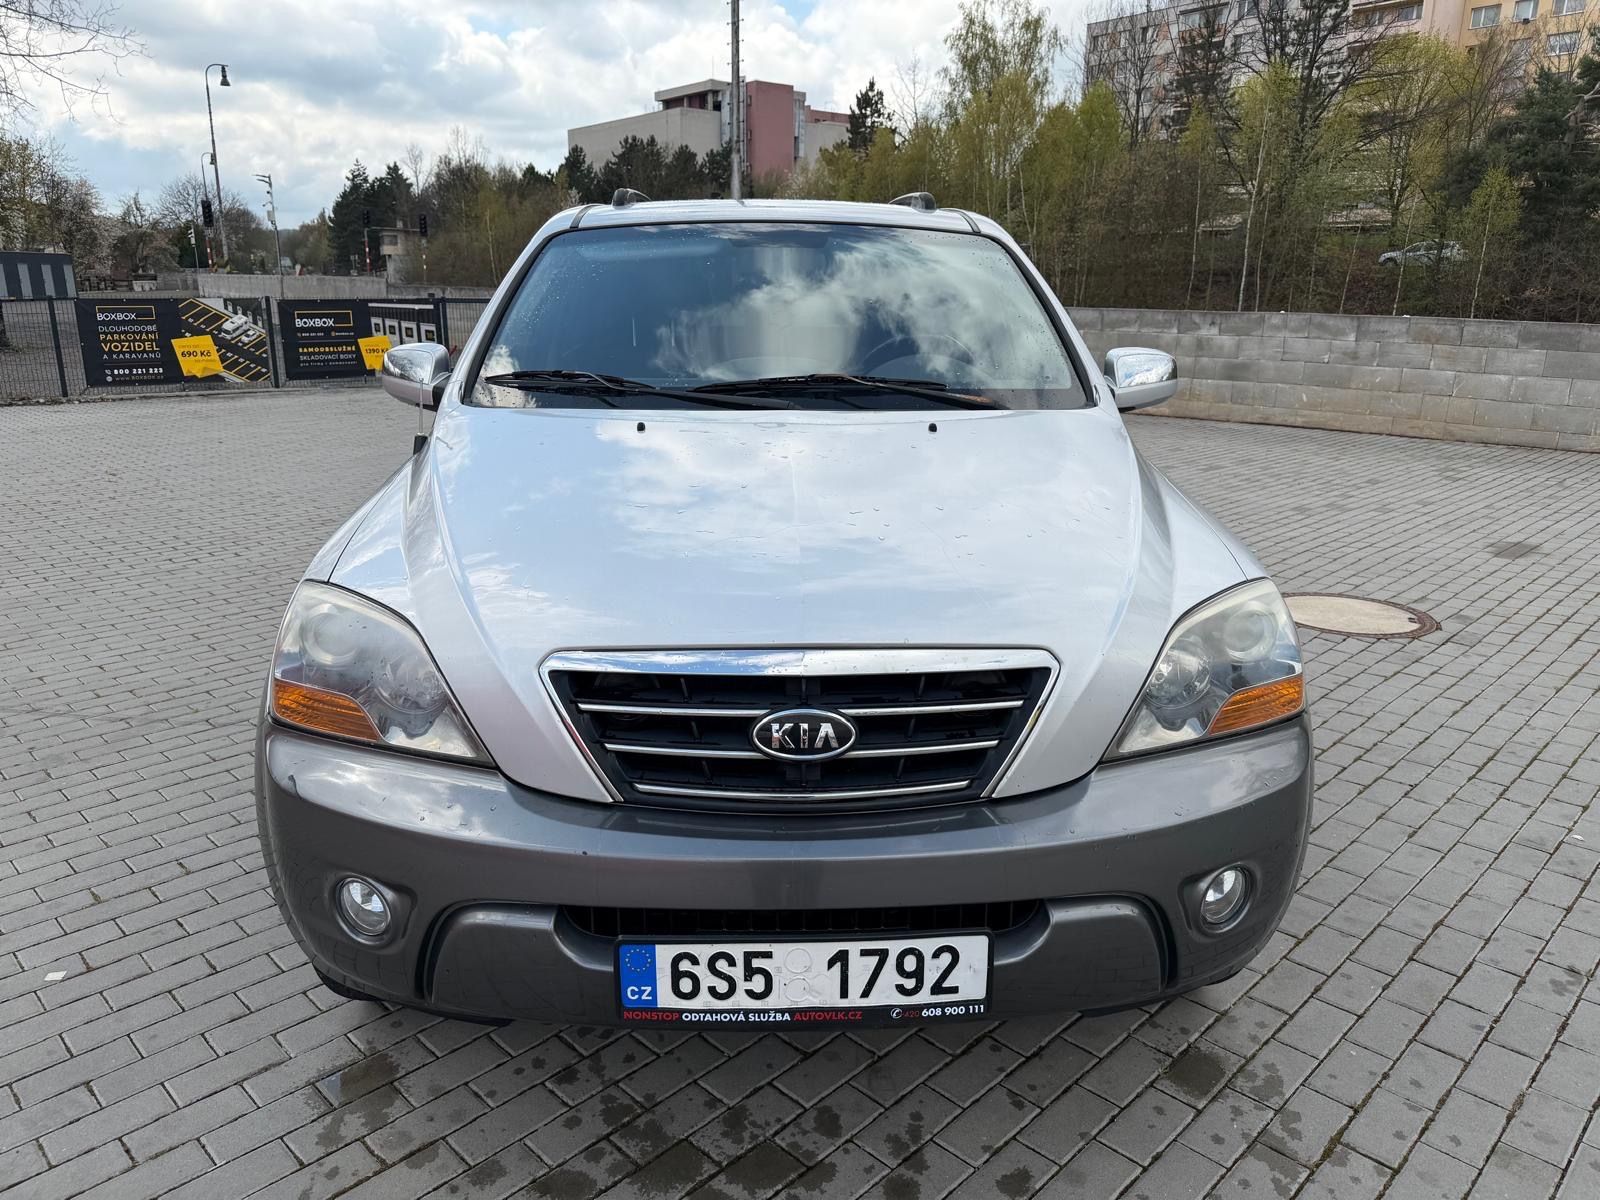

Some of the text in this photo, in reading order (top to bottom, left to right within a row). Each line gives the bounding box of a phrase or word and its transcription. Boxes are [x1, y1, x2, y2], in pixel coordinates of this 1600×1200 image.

[97, 312, 137, 321] BOXBOX
[98, 324, 158, 332] DLOUHODOBÉ
[295, 318, 335, 328] BOXBOX
[100, 332, 159, 341] PARKOVÁNÍ
[101, 342, 160, 352] VOZIDEL
[298, 345, 356, 353] SAMOOBSLUŽNÉ
[112, 352, 161, 360] KARAVANŮ
[181, 350, 212, 358] 690 Kč
[770, 723, 839, 748] KIA
[670, 944, 961, 1001] 6S5 1792
[626, 986, 653, 1000] CZ
[921, 1008, 942, 1017] 608
[944, 1006, 966, 1016] 900
[968, 1004, 984, 1014] 111
[623, 1010, 863, 1022] NONSTOP ODTAHOVÁ SLUŽBA AUTOVLK.CZ
